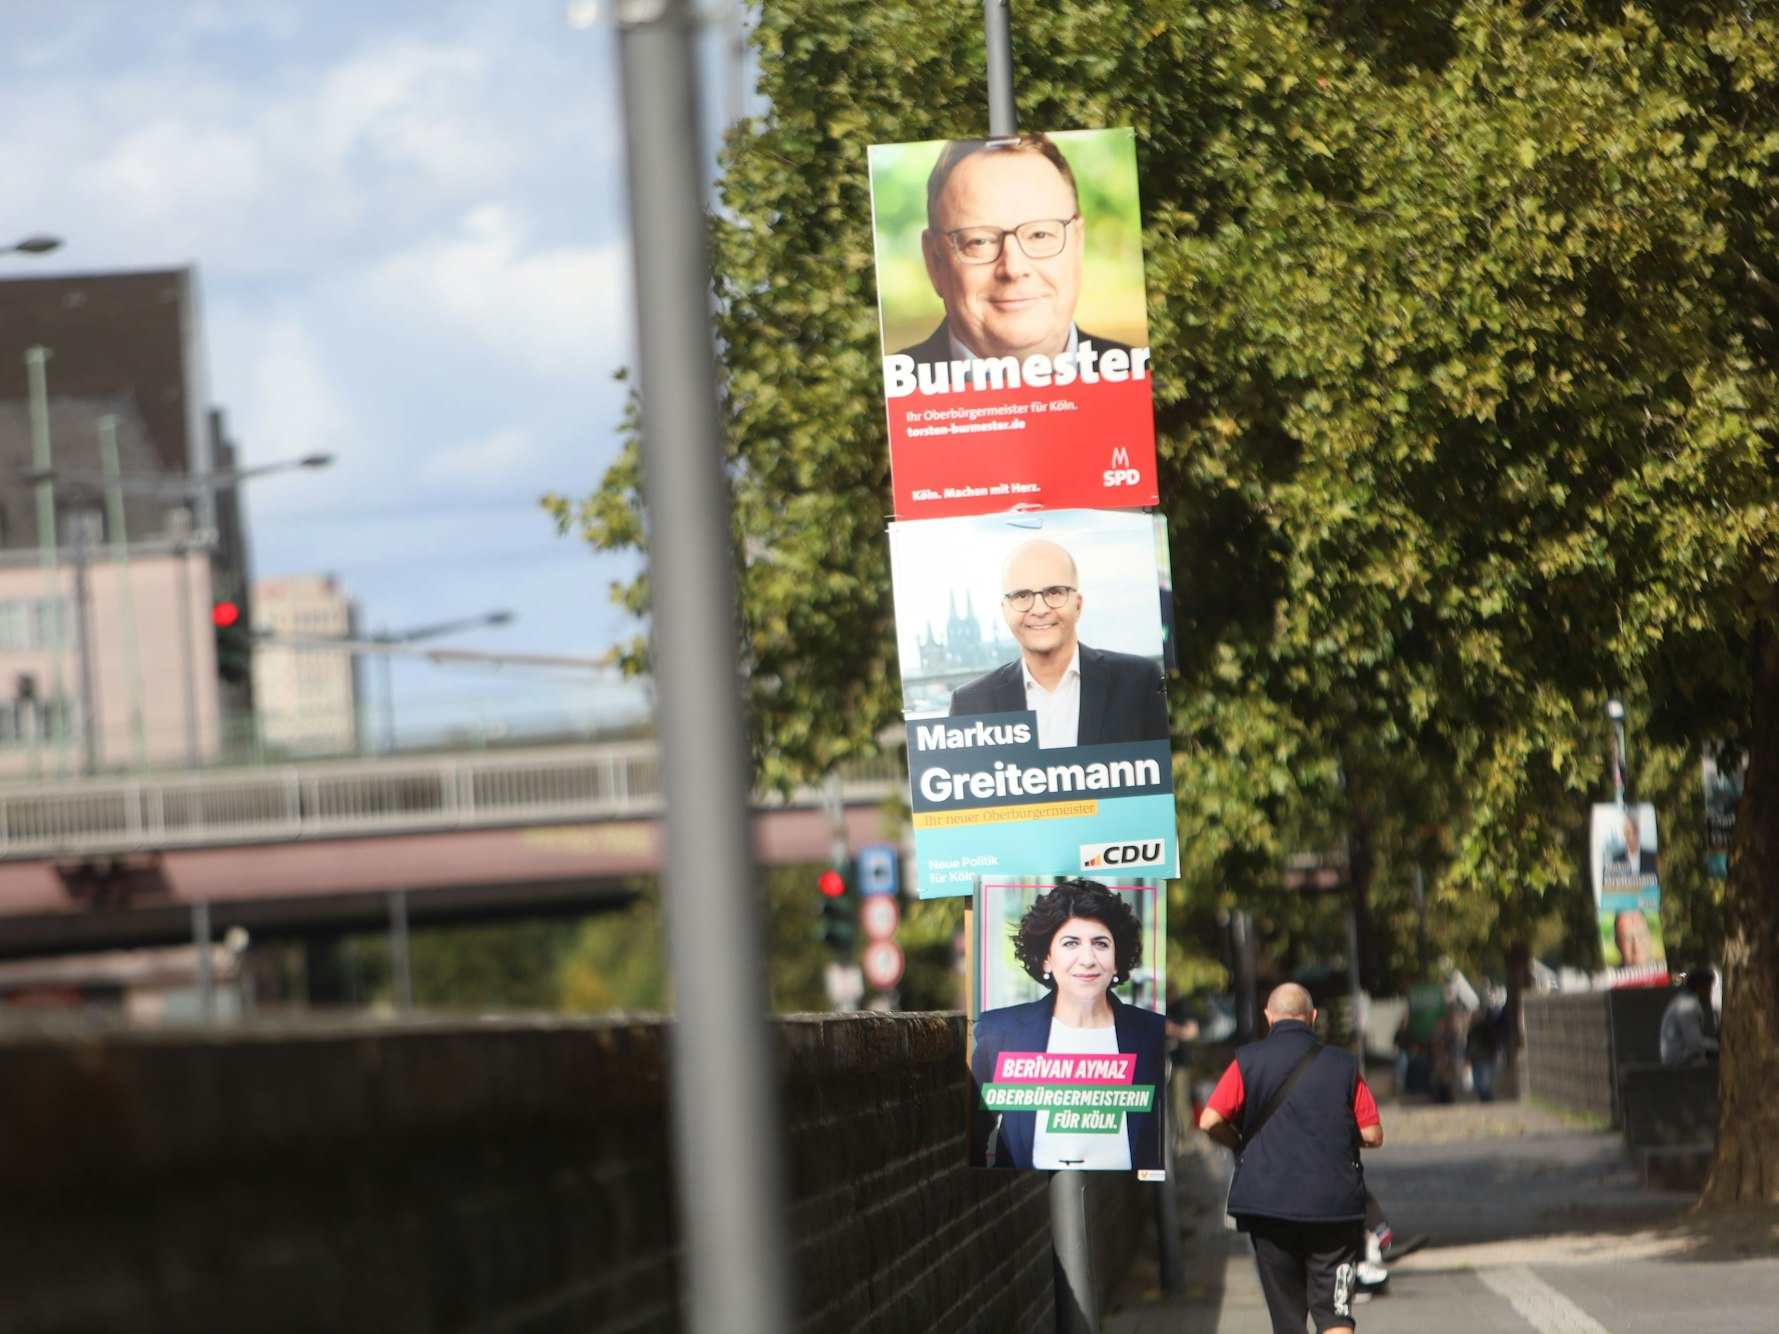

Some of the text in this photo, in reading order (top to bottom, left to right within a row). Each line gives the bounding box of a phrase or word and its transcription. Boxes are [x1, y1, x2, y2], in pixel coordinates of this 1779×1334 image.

[884, 340, 1150, 398] Burmester
[906, 400, 1077, 422] Ihr Oberbürgermeister für Köln.
[906, 418, 1026, 438] torsten-burmester.de
[1103, 468, 1140, 487] SPD
[912, 483, 1041, 501] Köln. Machen mit Herz.
[916, 721, 1032, 751] Markus
[920, 758, 1161, 802] Greitemann
[925, 803, 1096, 827] Ihr neuer Oberbürgermeister
[928, 855, 999, 870] Neue Politik
[1103, 843, 1161, 865] CDU
[930, 873, 947, 884] für
[1074, 1059, 1129, 1080] AYMAZ
[985, 1086, 1150, 1107] OBERBÜRGERMEISTERIN
[1052, 1110, 1117, 1129] FÜR KÖLN.
